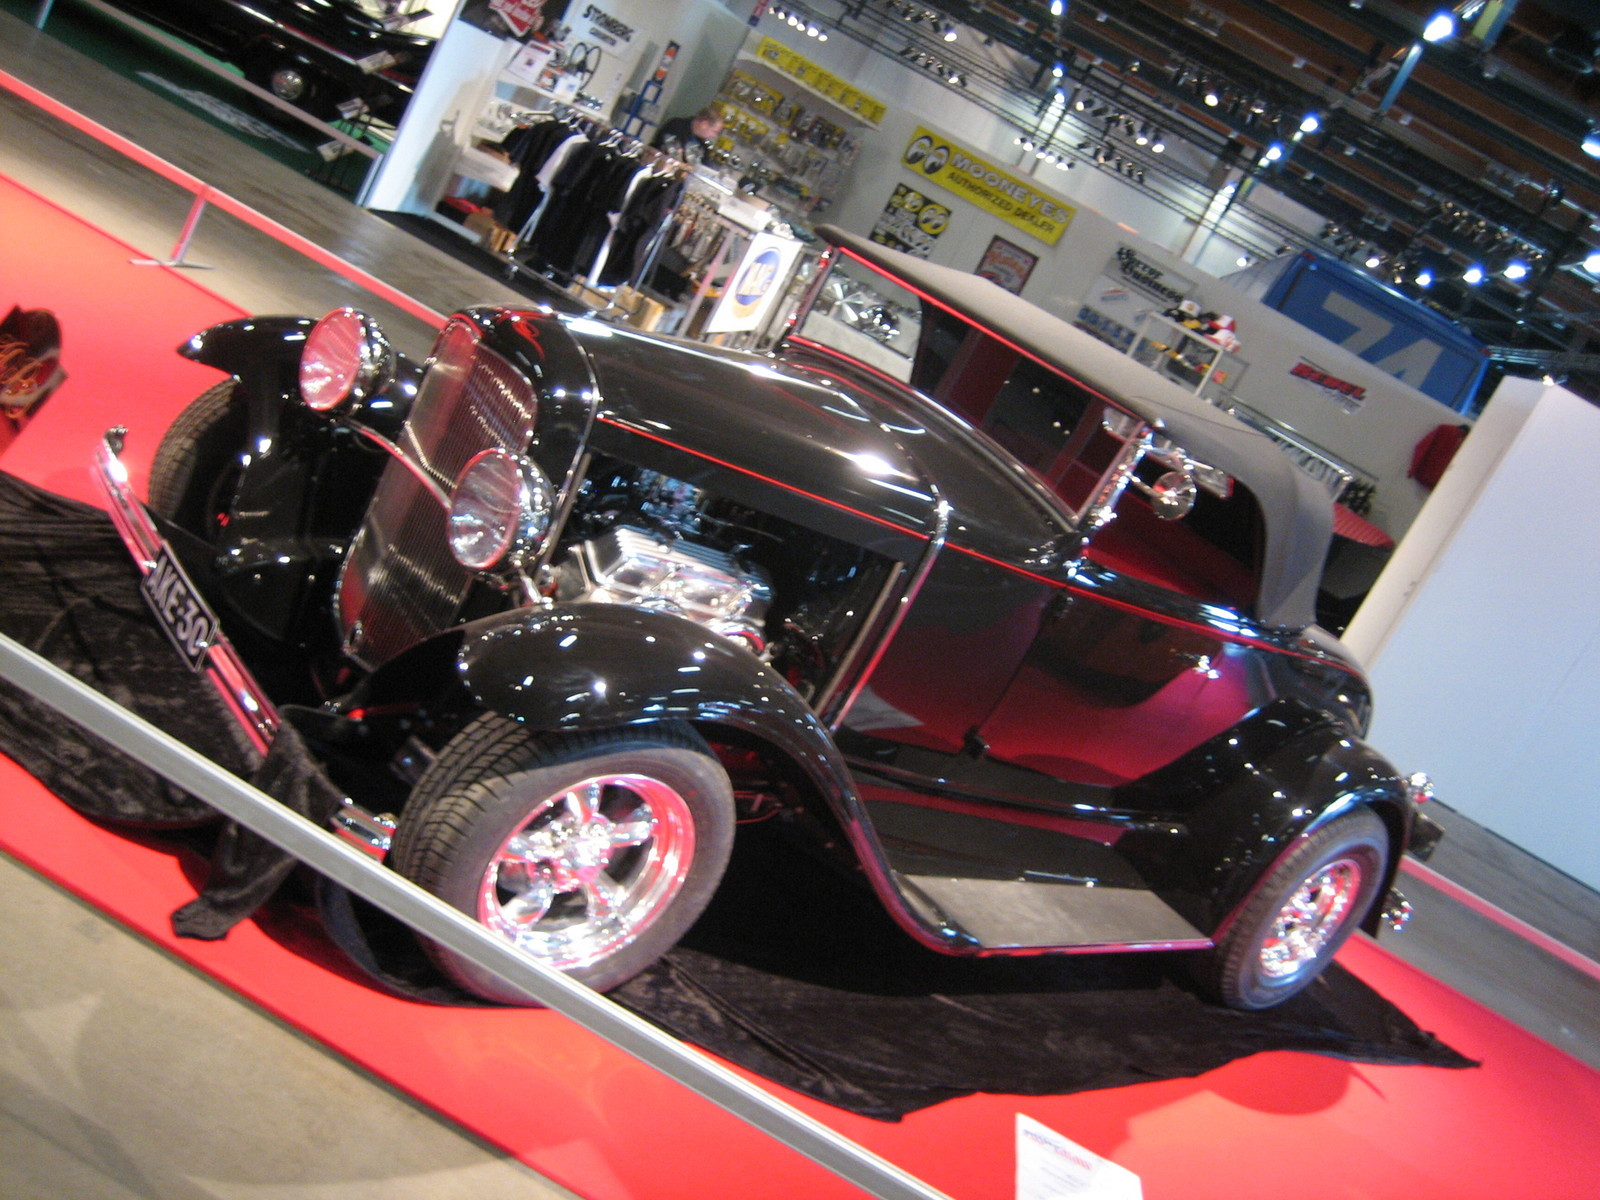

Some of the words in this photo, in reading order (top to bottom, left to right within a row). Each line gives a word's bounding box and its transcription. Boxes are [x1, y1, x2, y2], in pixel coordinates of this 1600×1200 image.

[948, 172, 1012, 211] AUTHORIZED
[1013, 206, 1056, 233] DEALER
[951, 153, 1071, 224] MOONEYES
[147, 555, 209, 656] AKE-30
